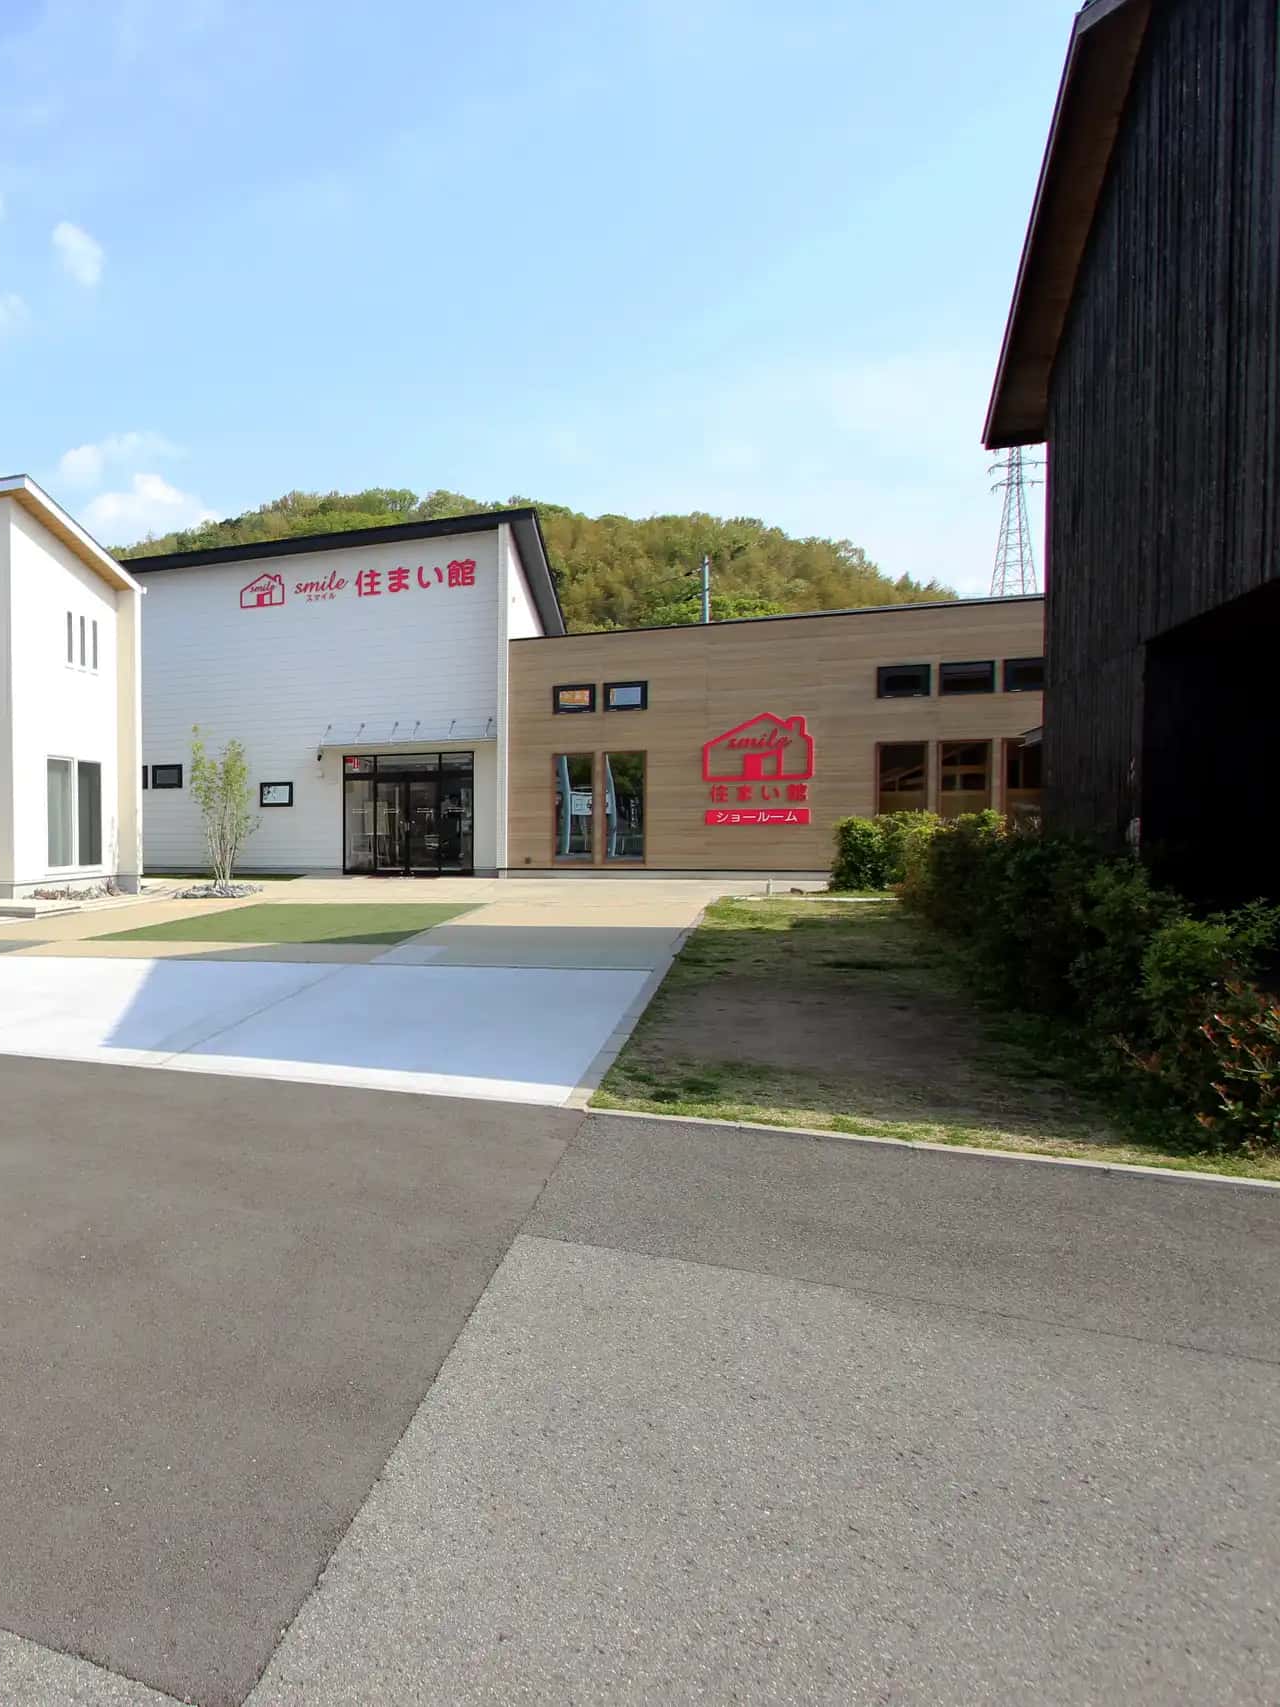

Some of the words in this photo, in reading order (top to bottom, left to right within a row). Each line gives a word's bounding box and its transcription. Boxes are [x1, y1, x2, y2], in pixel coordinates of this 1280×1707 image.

[249, 580, 276, 593] smile
[293, 570, 348, 594] smile
[355, 558, 476, 597] 住まい館
[726, 727, 793, 750] smile
[710, 783, 808, 803] 住まい館
[716, 811, 798, 823] ショールーム
